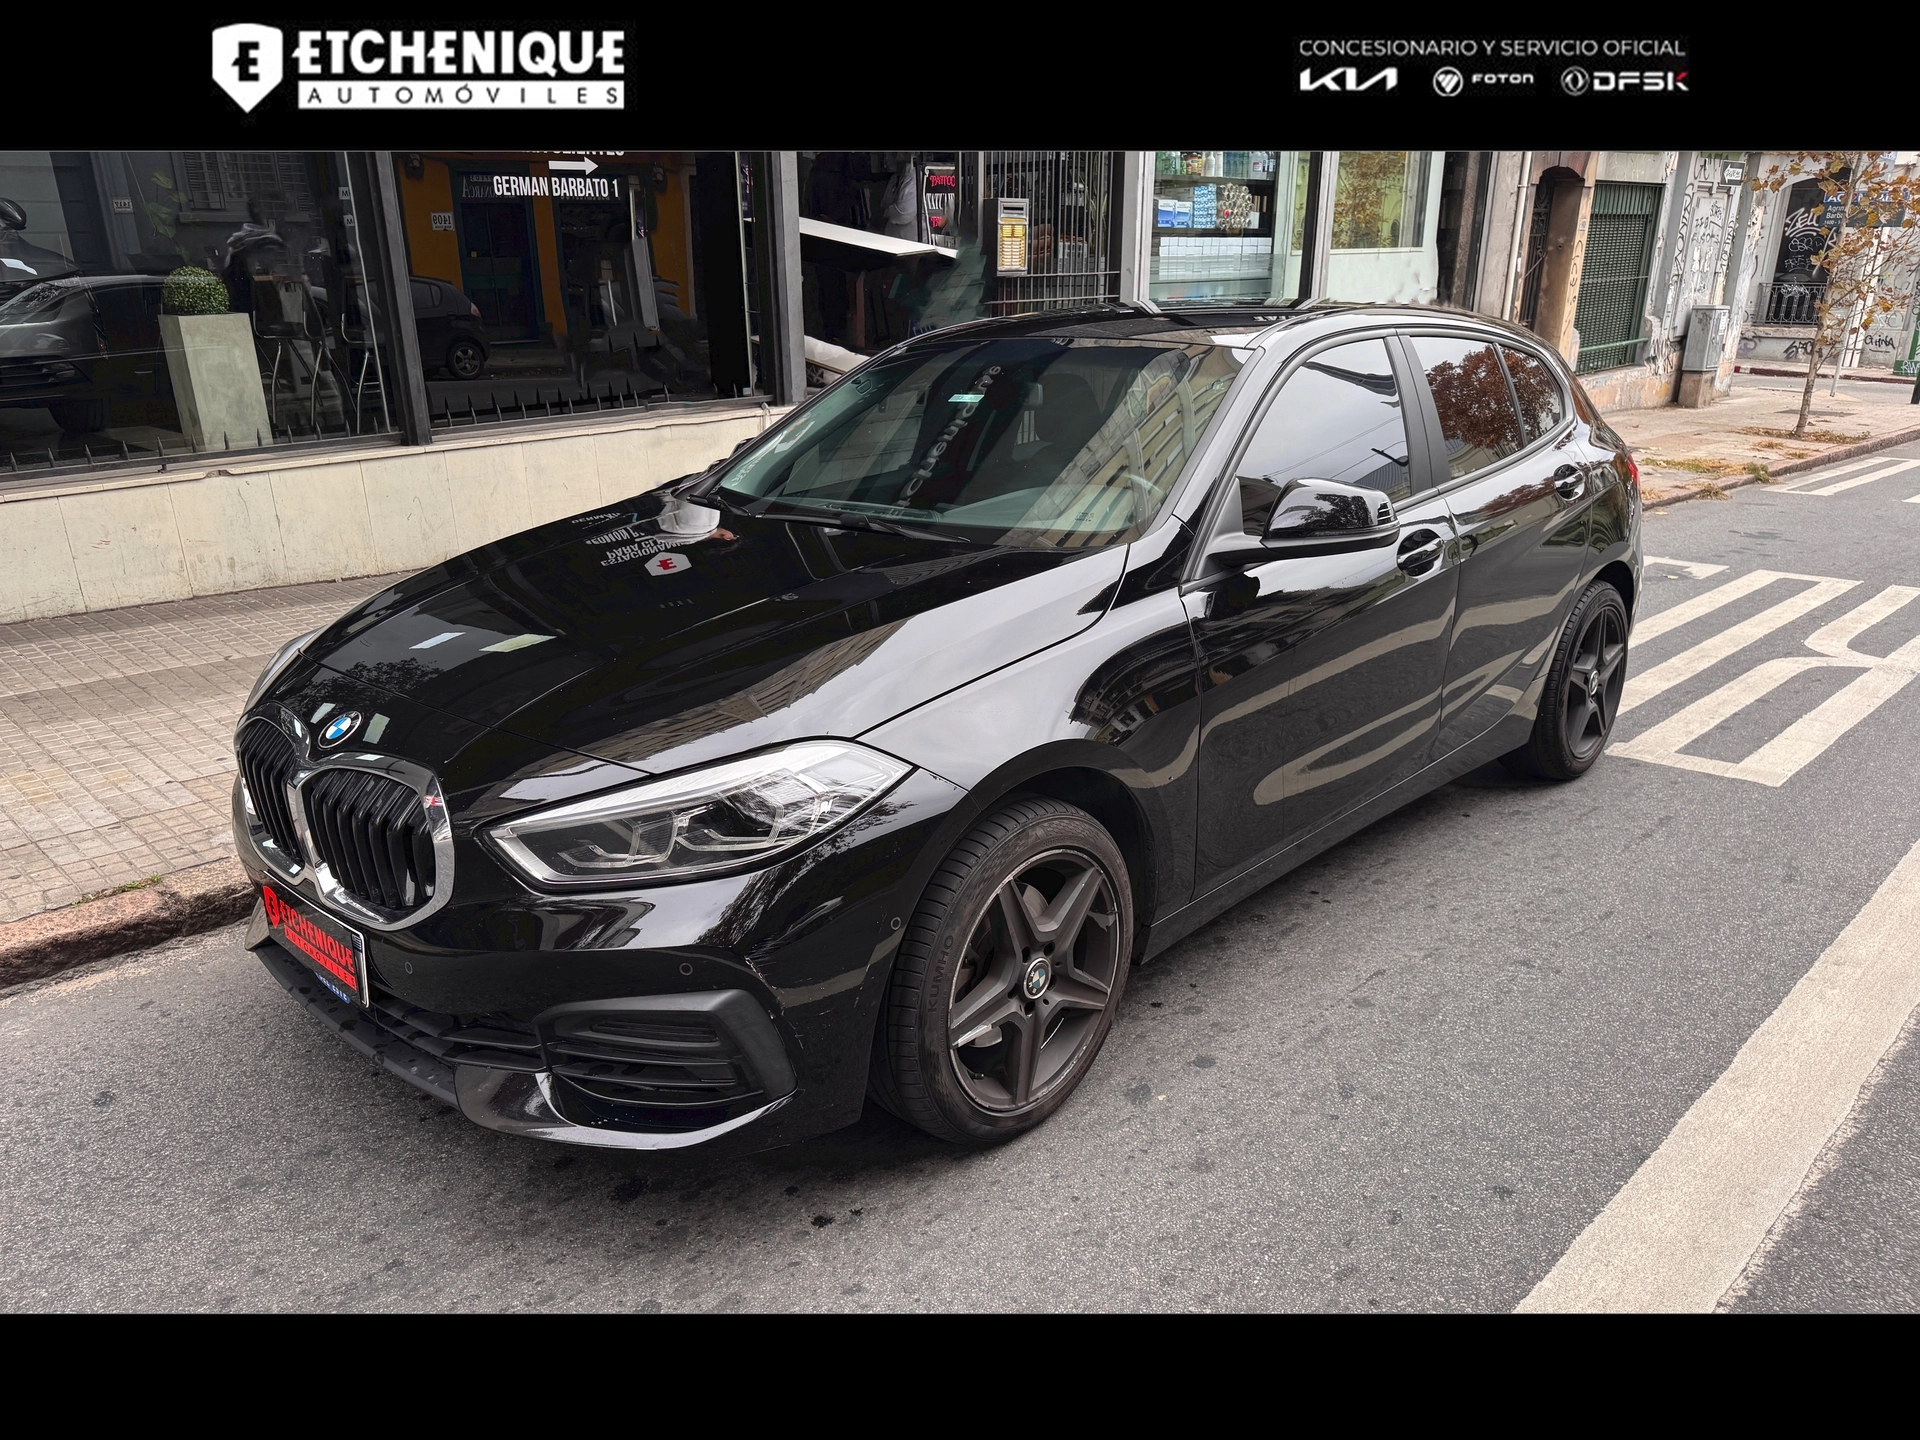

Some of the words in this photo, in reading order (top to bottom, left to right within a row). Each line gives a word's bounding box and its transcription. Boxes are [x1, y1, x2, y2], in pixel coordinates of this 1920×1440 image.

[493, 175, 549, 198] GERMAN
[551, 177, 609, 198] BARBATO
[279, 899, 355, 974] ETCHENIQUE
[927, 934, 954, 1013] KUMHO
